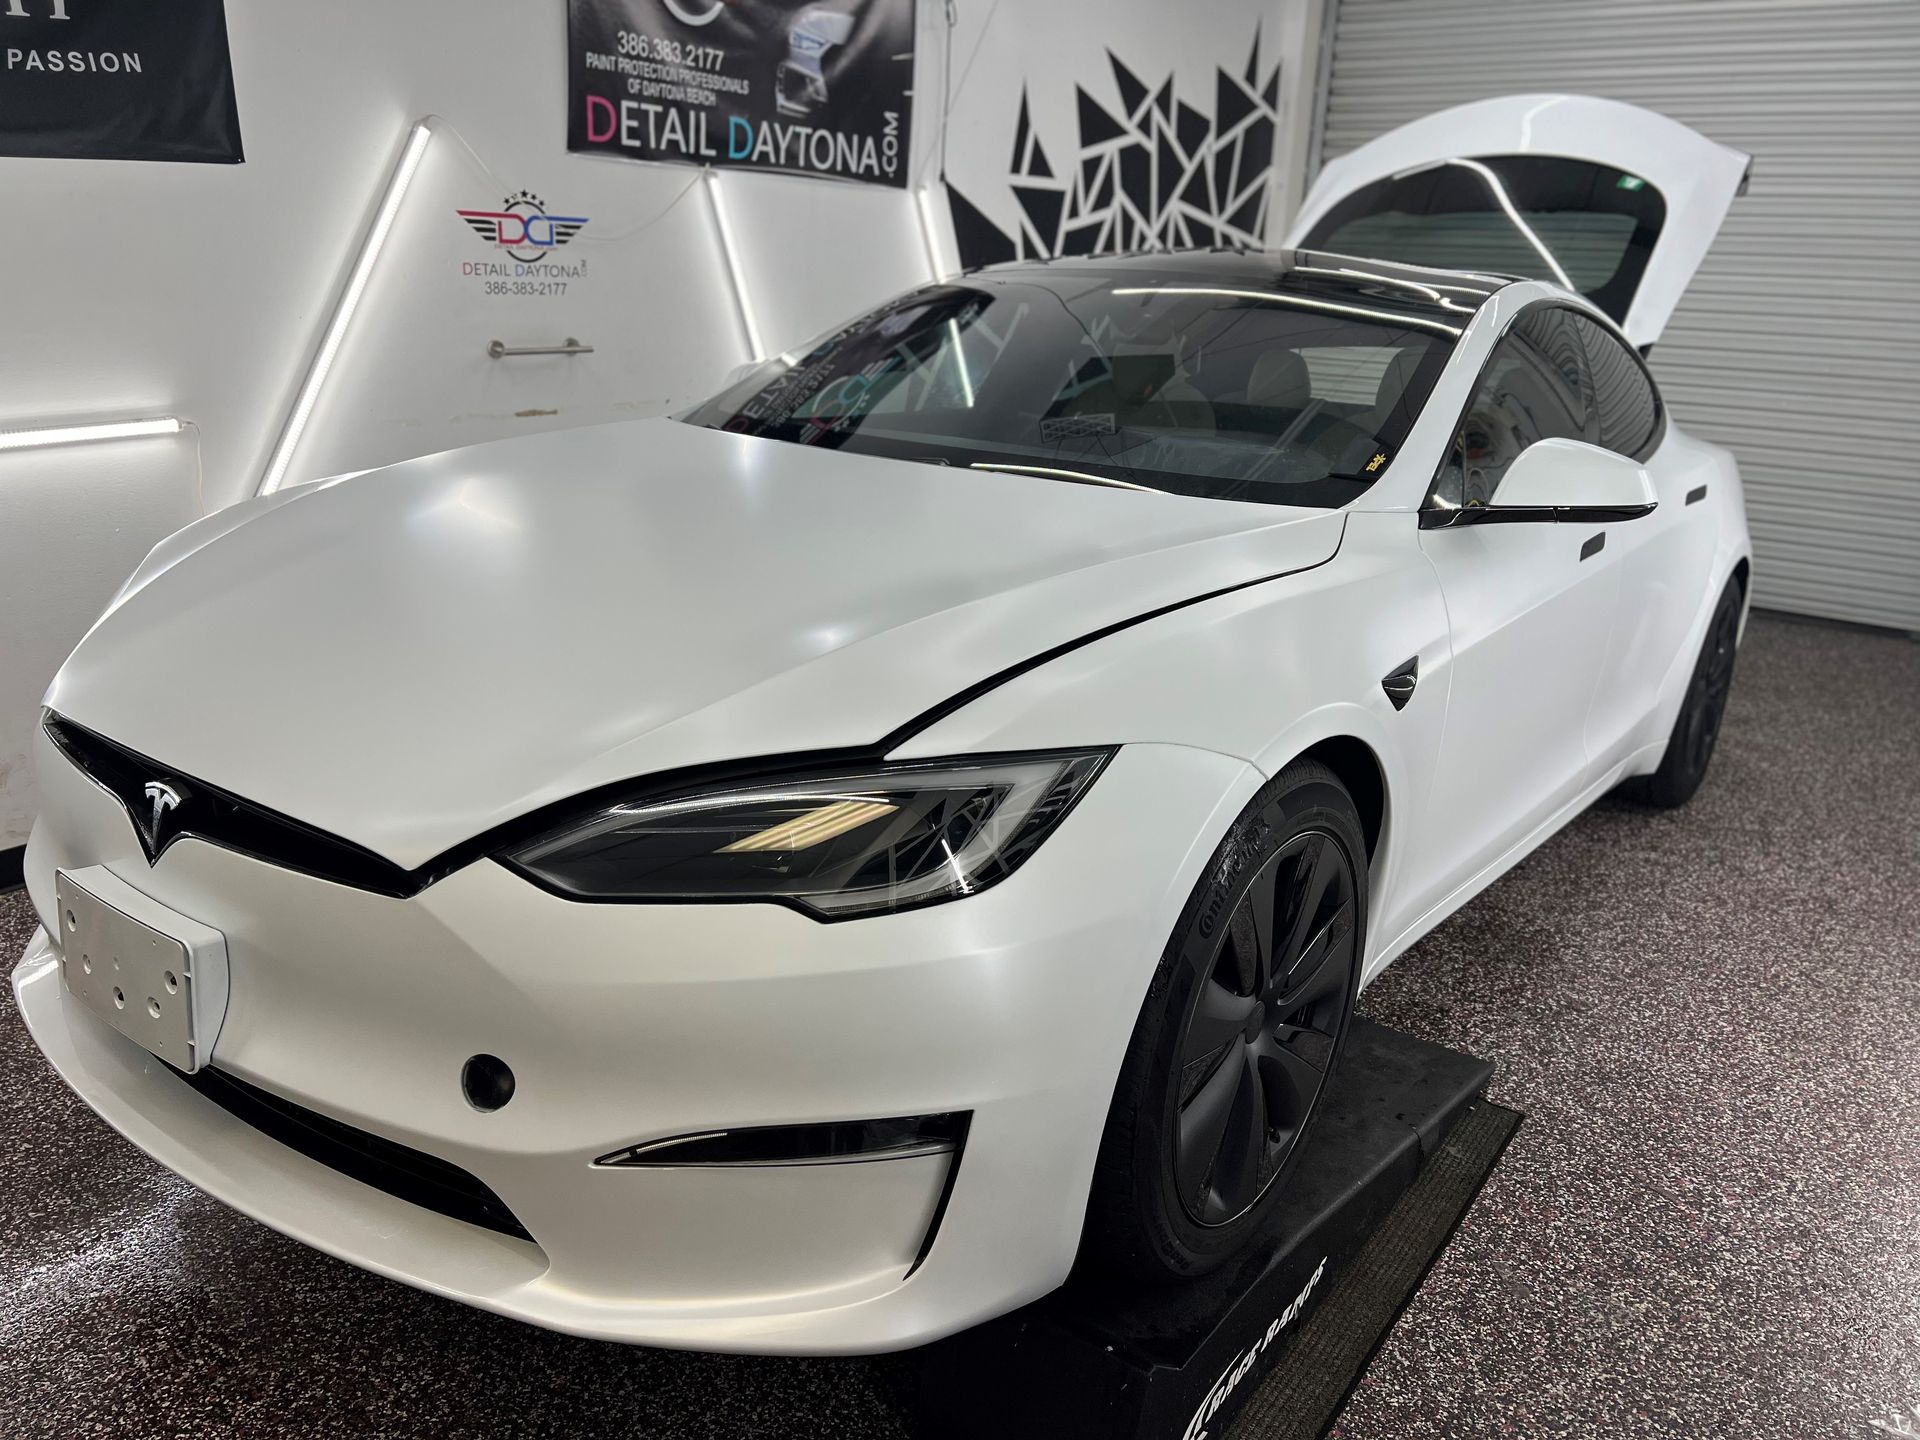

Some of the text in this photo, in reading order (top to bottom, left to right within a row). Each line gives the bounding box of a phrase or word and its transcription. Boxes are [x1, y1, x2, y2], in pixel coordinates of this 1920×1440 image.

[7, 48, 142, 73] PASSION
[617, 30, 725, 72] 386.383.2177
[586, 52, 750, 95] PAINT PROTECTION PROFESSIONALS
[627, 78, 717, 106] OF DAYTONA BEACH
[586, 95, 899, 178] DETAIL DAYTONA .COM
[462, 262, 511, 276] DETAIL
[515, 264, 580, 279] DAYTONA
[484, 281, 568, 297] 386-383-2177
[1205, 1255, 1328, 1424] RACE RAMPS
